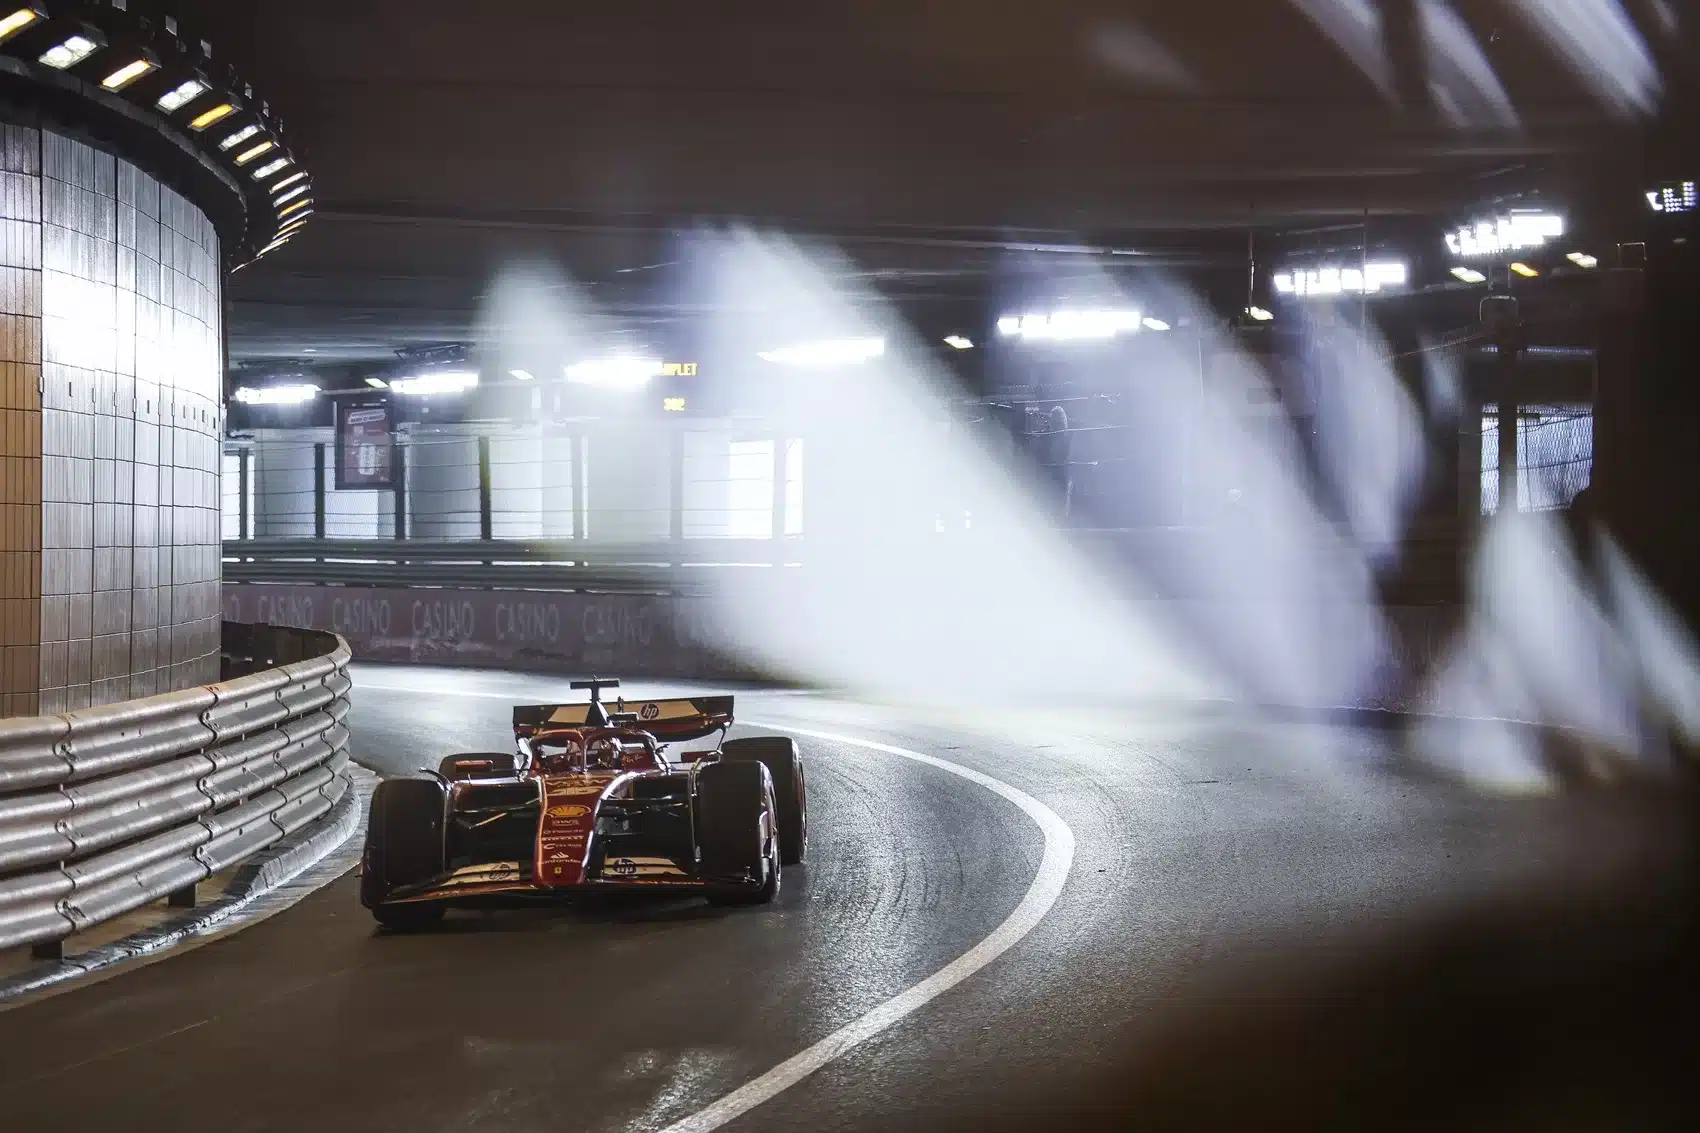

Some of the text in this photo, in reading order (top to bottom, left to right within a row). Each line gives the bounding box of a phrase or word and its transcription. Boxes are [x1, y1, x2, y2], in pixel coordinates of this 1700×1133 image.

[333, 597, 391, 634] CASINO
[412, 600, 475, 640] CASINO
[496, 602, 560, 642] CASINO
[641, 703, 660, 720] hp
